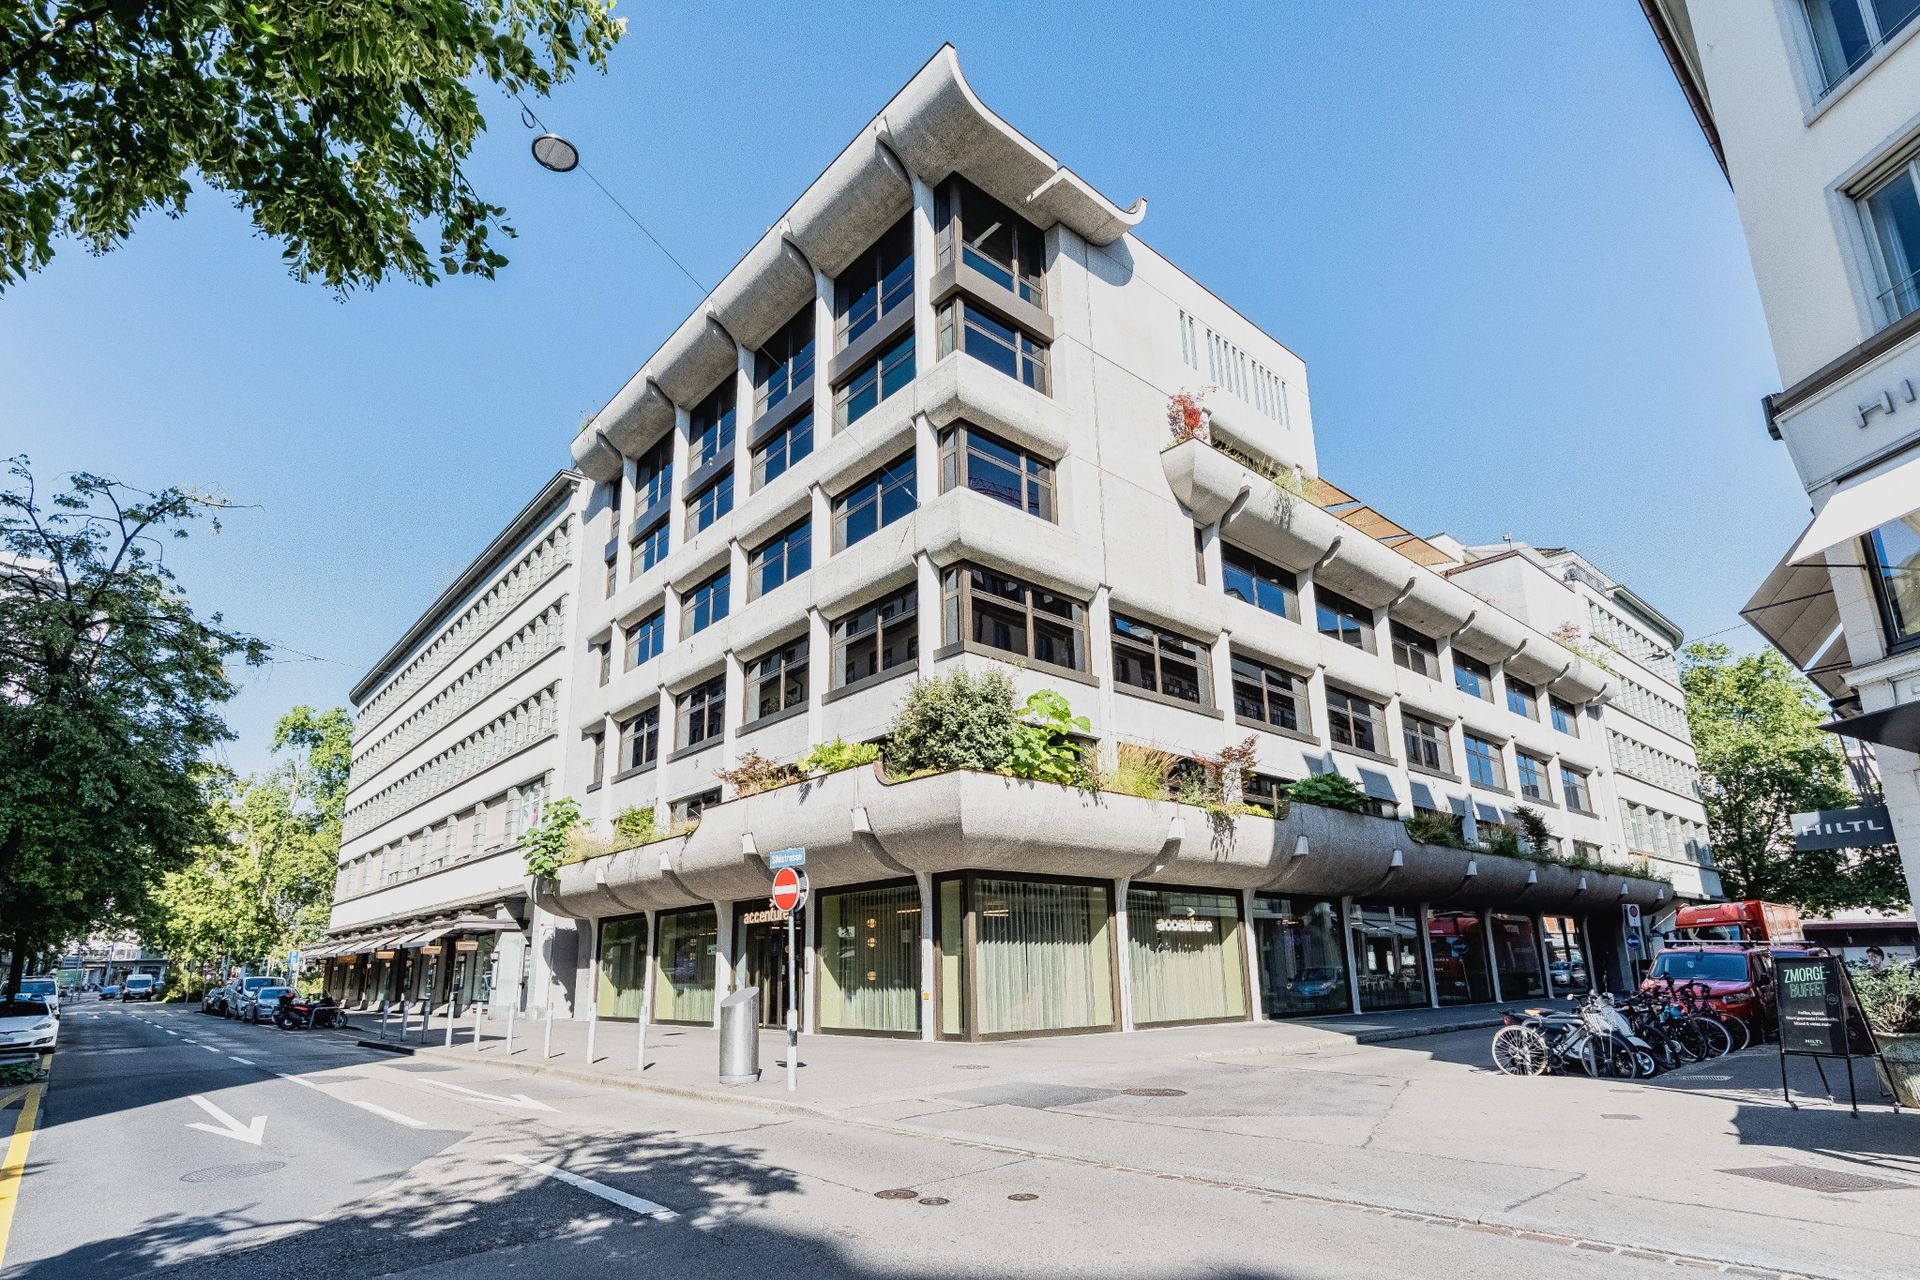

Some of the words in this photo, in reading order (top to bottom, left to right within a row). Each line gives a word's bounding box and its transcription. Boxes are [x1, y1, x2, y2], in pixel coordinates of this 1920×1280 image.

[1801, 819, 1885, 837] HILTL
[743, 907, 790, 925] accenture
[1156, 917, 1213, 933] accenture
[1784, 965, 1831, 984] ZMORGE-
[1789, 981, 1828, 998] BUFFET
